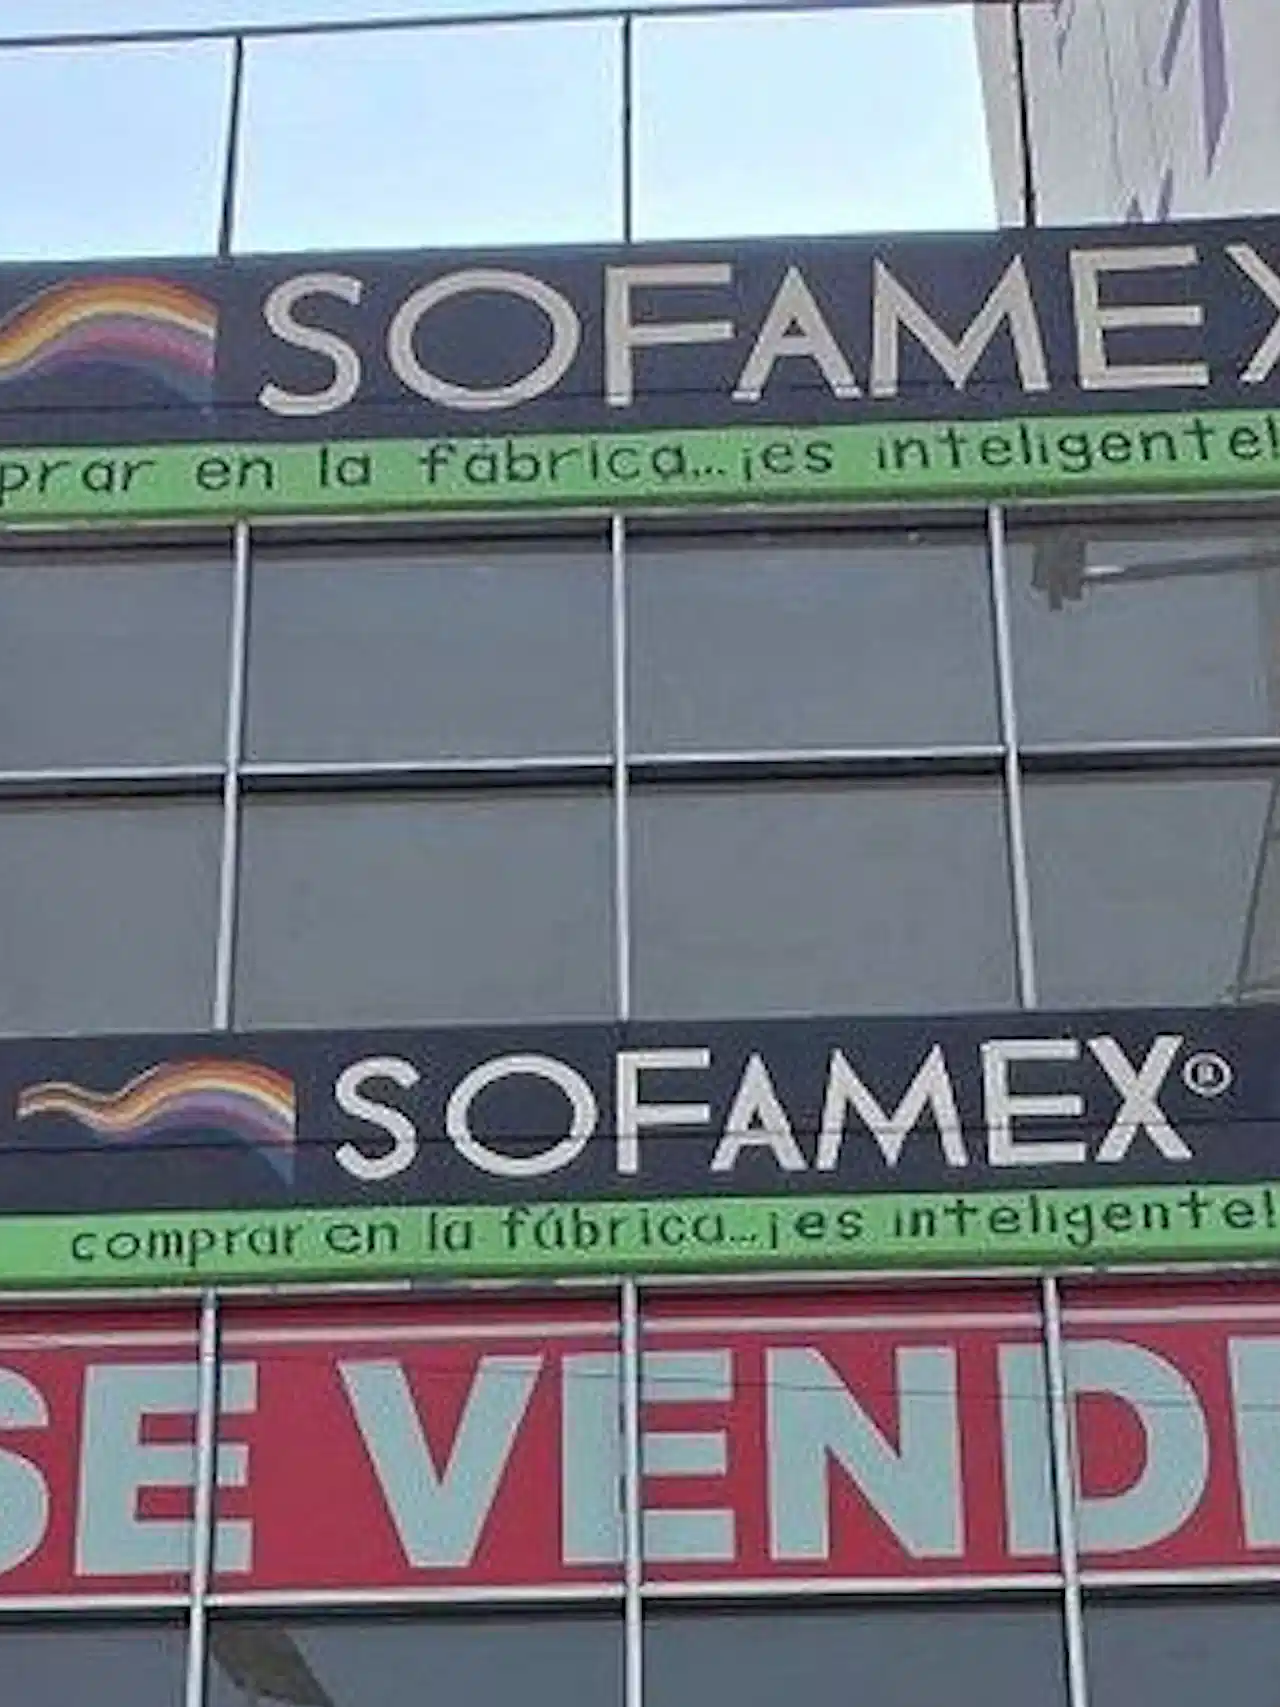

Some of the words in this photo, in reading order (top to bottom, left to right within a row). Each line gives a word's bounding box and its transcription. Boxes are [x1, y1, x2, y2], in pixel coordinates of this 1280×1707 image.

[195, 452, 274, 492] en
[319, 446, 372, 488] la
[71, 1220, 304, 1269] comprar
[324, 1217, 399, 1253] en
[429, 1209, 474, 1252] la
[892, 1187, 1278, 1246] inteligente!
